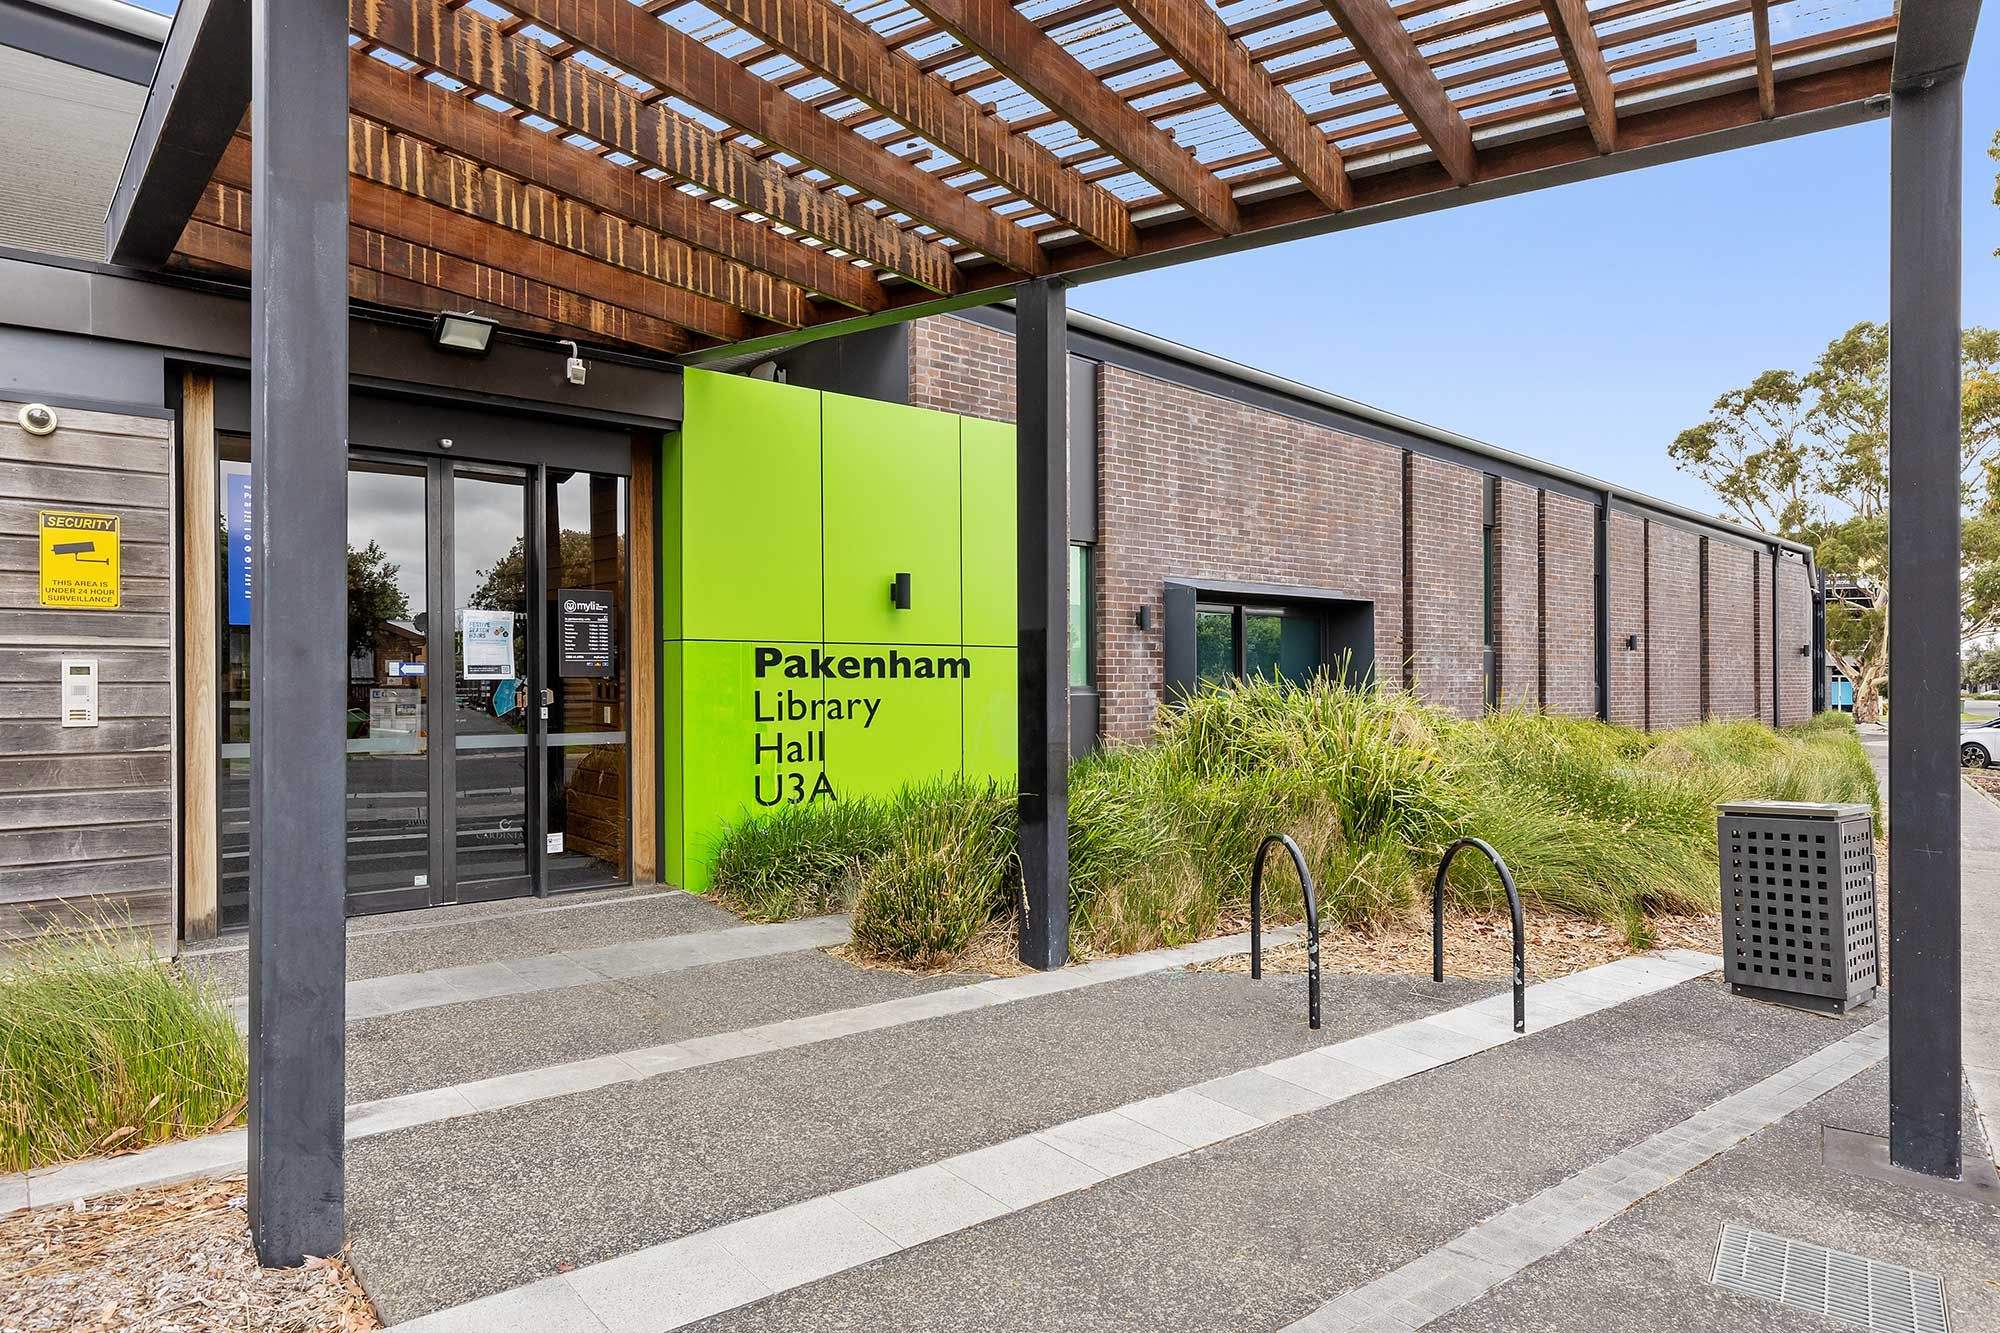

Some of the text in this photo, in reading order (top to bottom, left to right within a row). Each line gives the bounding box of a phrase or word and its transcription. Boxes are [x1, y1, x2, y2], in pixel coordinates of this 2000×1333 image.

[47, 516, 112, 530] SECURITY
[47, 595, 113, 603] SURVEILLANCE
[90, 588, 115, 596] HOUR
[577, 601, 596, 612] myli
[754, 647, 971, 679] Pakenham
[754, 689, 882, 729] Library
[754, 730, 825, 765] Hall
[754, 771, 838, 807] U3A
